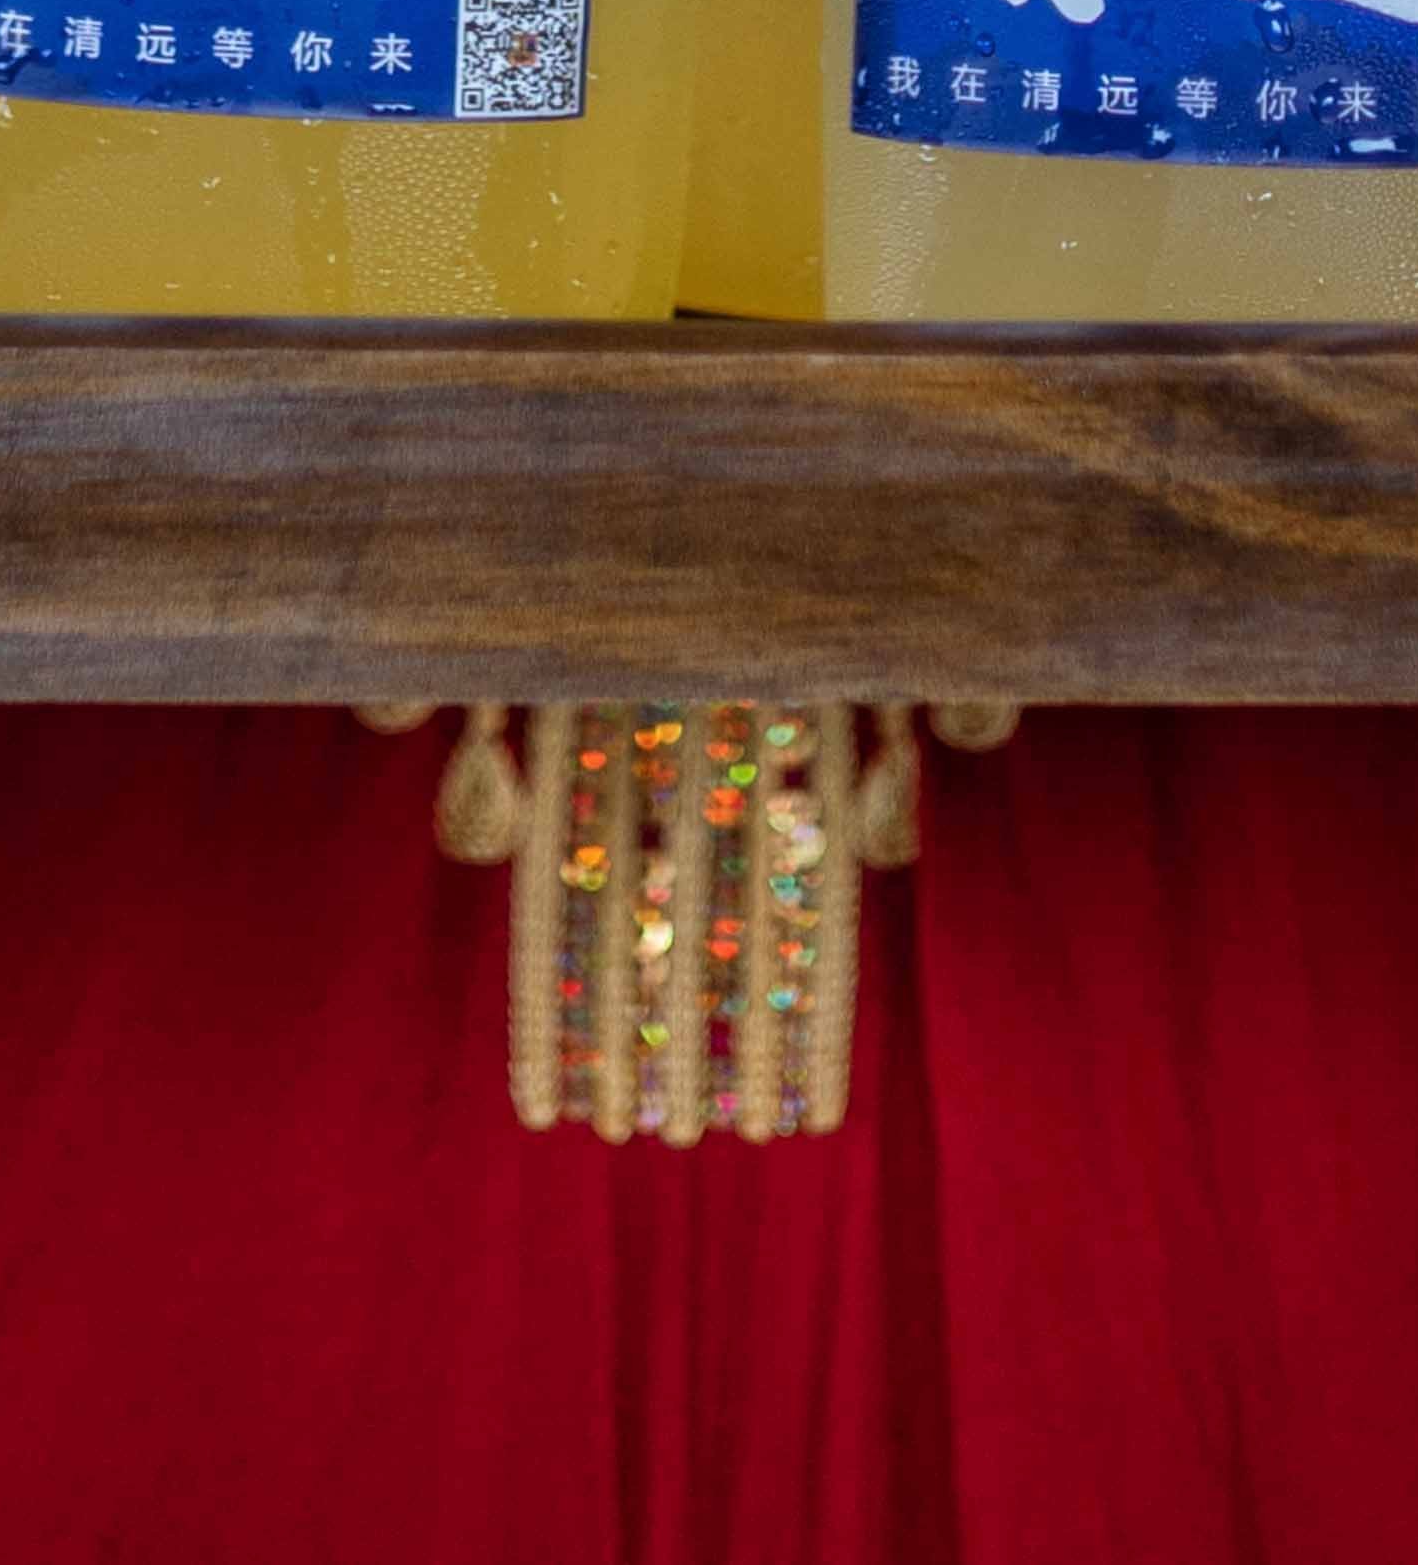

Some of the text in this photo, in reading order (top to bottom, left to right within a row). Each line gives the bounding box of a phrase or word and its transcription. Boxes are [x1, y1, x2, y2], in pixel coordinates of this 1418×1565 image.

[886, 56, 1377, 122] 我在清远等你来
